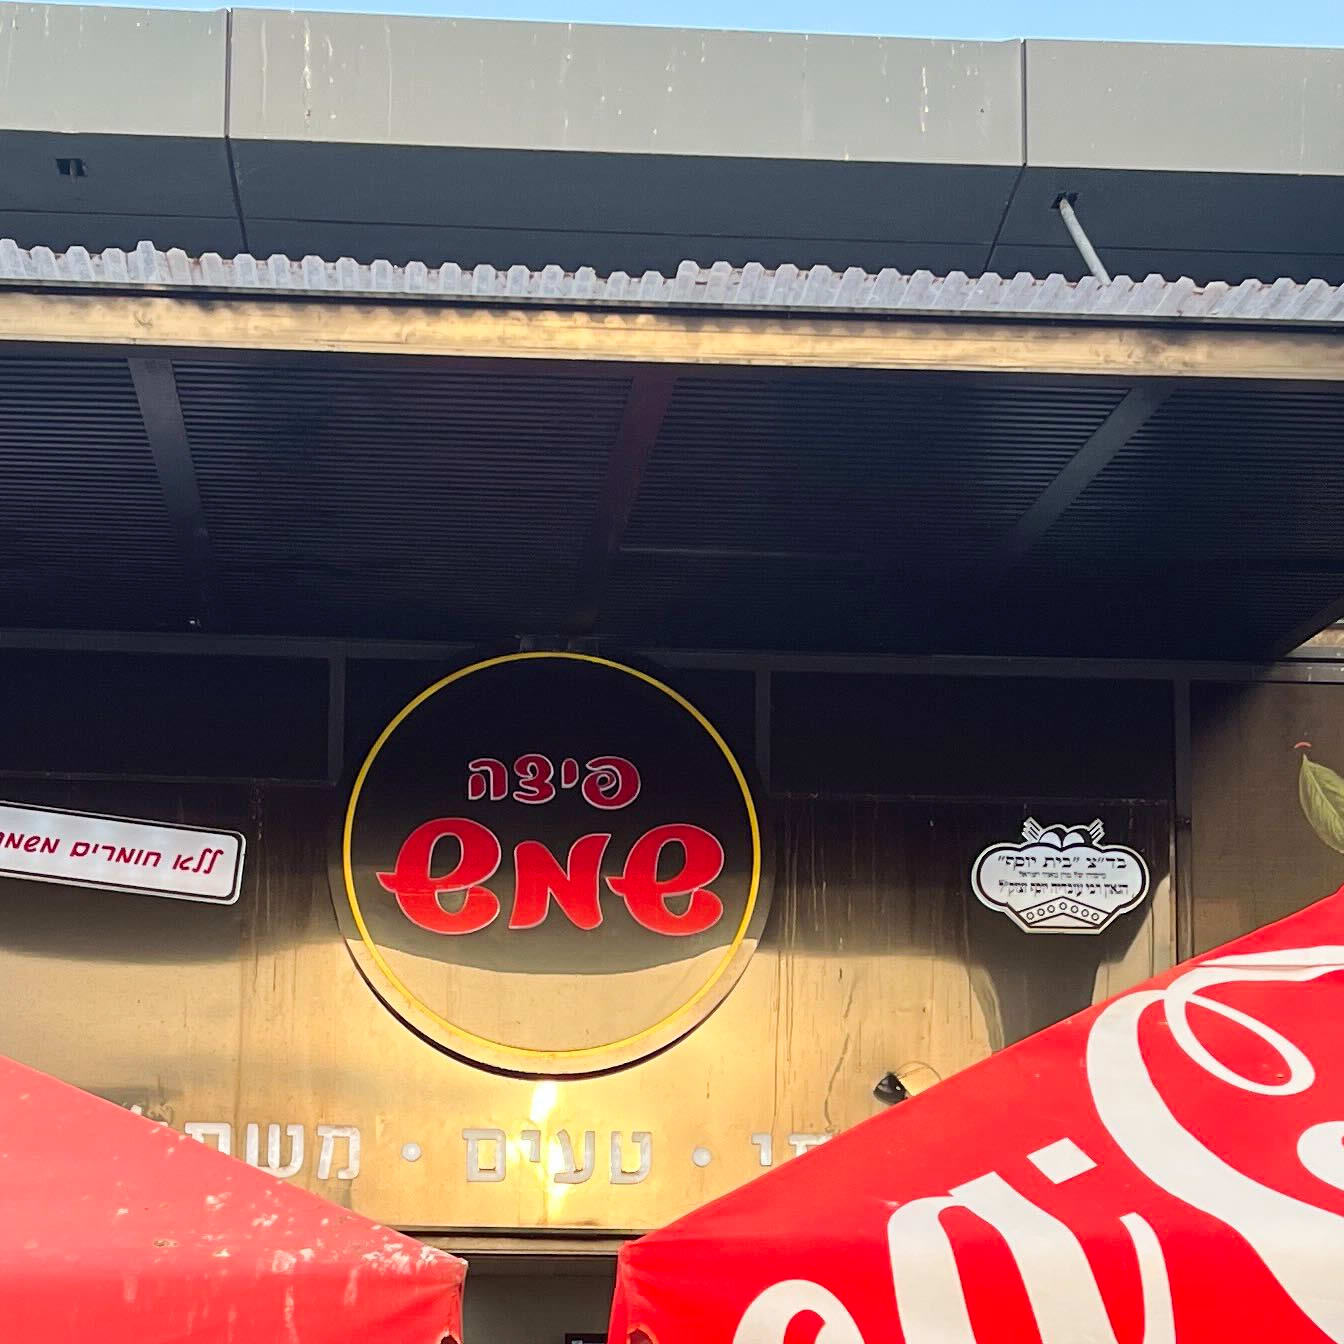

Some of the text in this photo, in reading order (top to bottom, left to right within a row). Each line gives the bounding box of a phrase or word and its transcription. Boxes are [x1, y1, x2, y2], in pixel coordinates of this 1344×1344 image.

[467, 753, 641, 809] פיצה
[69, 842, 162, 867] חומרים
[173, 847, 224, 874] ללא
[376, 817, 725, 936] שמש
[158, 1119, 652, 1186] טעים משת
